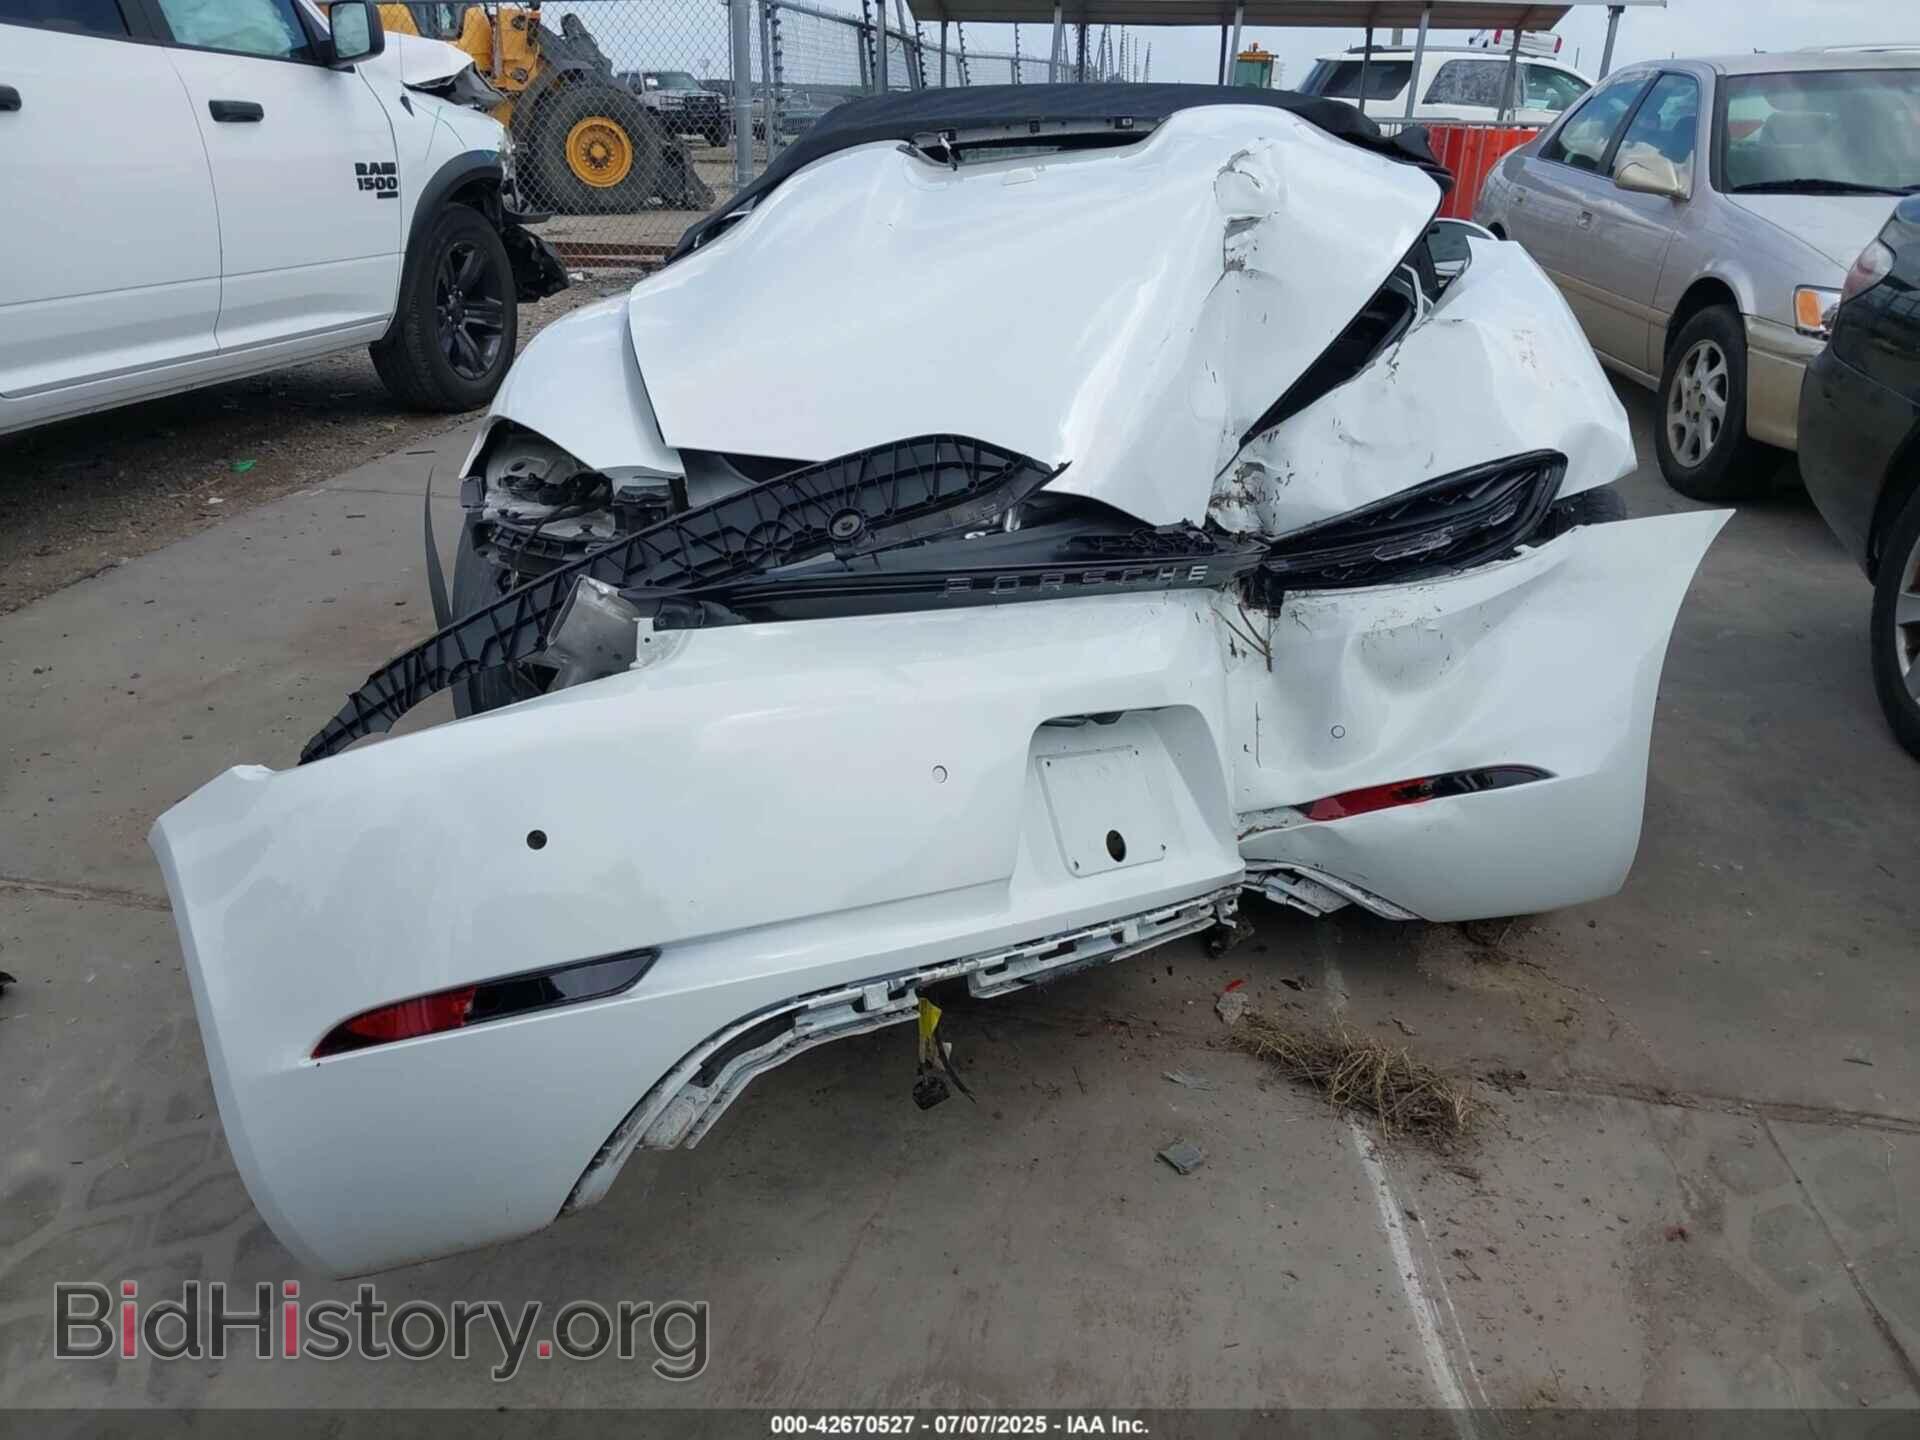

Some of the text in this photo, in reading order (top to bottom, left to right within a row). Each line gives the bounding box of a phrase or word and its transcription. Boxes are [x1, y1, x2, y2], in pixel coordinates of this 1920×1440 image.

[355, 162, 397, 176] RAM
[356, 176, 398, 191] 1500
[940, 565, 1208, 597] PORSCHE
